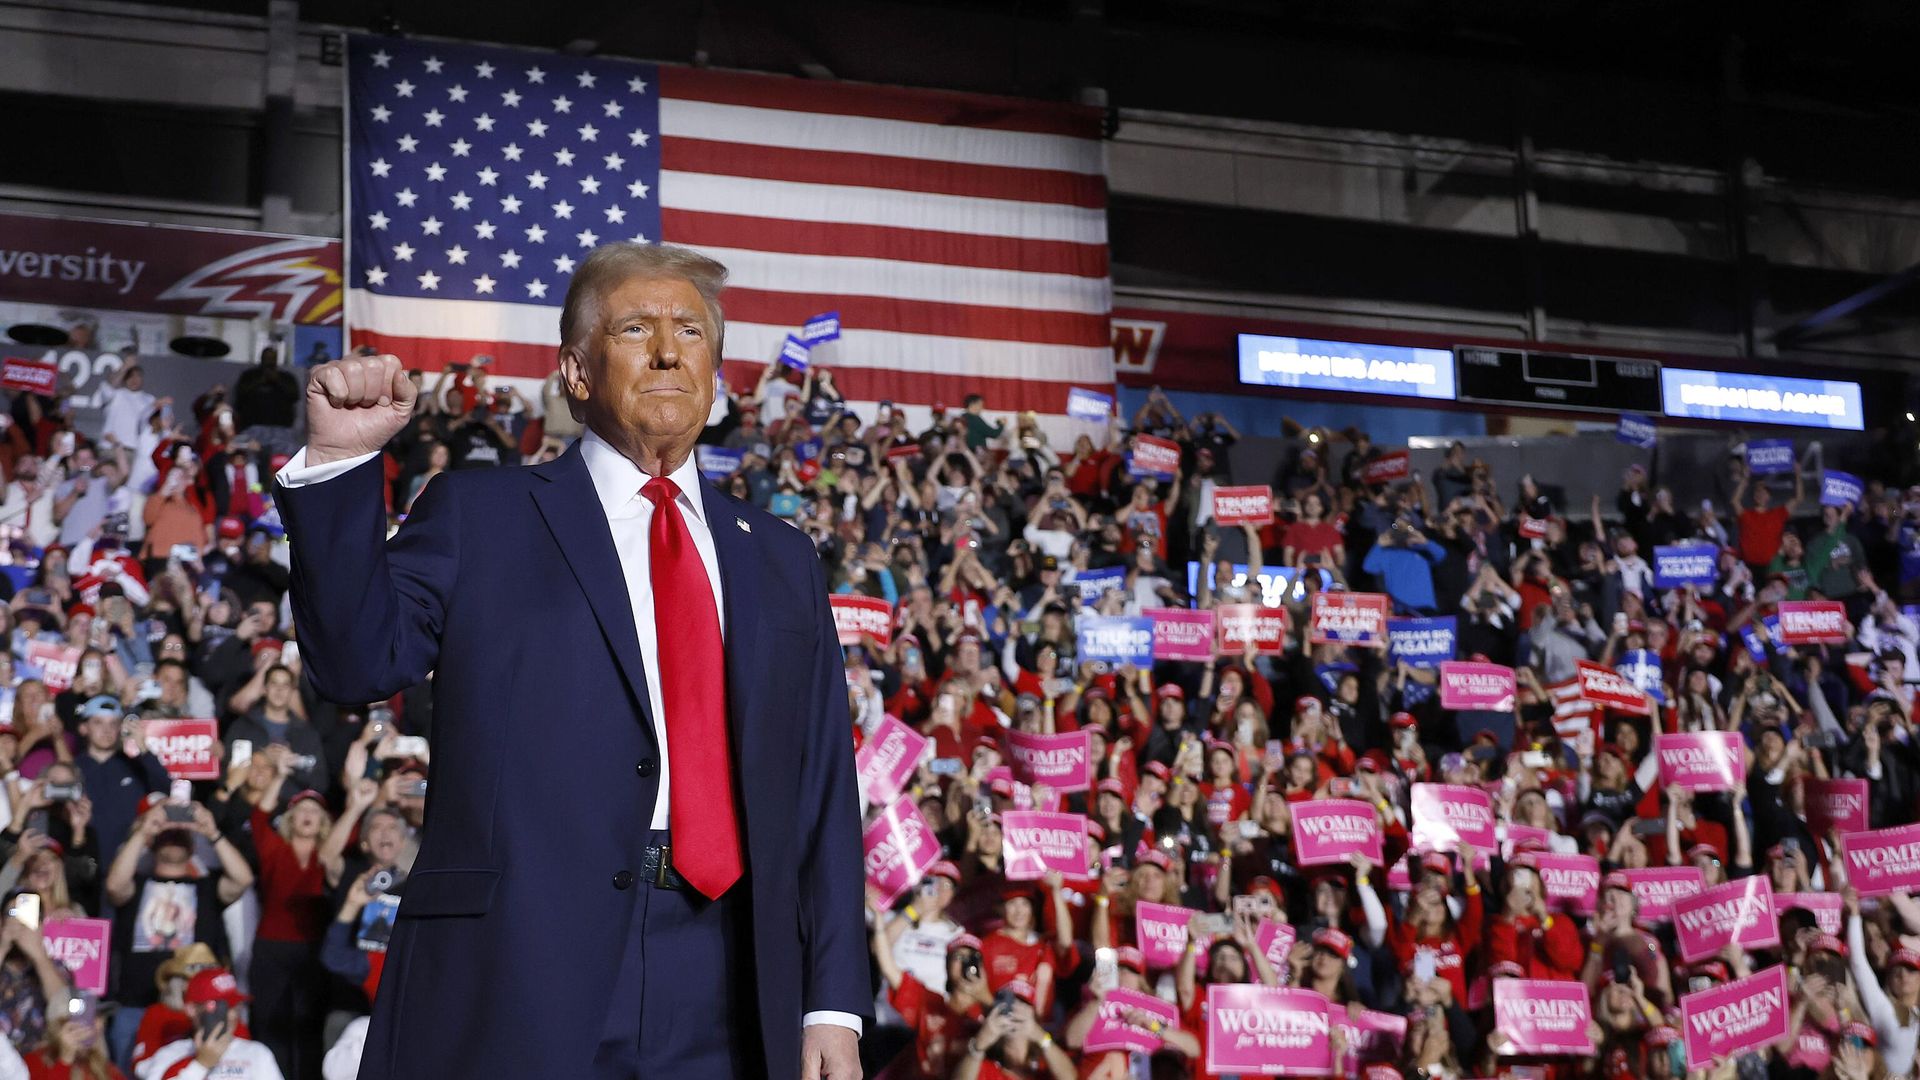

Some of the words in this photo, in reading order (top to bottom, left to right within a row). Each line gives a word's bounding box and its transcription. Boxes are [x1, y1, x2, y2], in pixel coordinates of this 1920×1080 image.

[1084, 629, 1151, 645] TRUMP
[1447, 672, 1513, 690] WOMEN
[145, 734, 213, 752] RUMP
[1439, 801, 1493, 825] OMEN
[1300, 815, 1376, 836] WOMEN
[1010, 827, 1083, 849] WOMEN
[1540, 867, 1600, 890] OMEN
[44, 935, 100, 960] MEN
[1503, 999, 1585, 1021] WOMEN
[1691, 986, 1783, 1035] WOMEN
[1216, 1008, 1329, 1036] WOMEN
[1235, 1034, 1256, 1050] for
[1256, 1035, 1312, 1049] TRUMP
